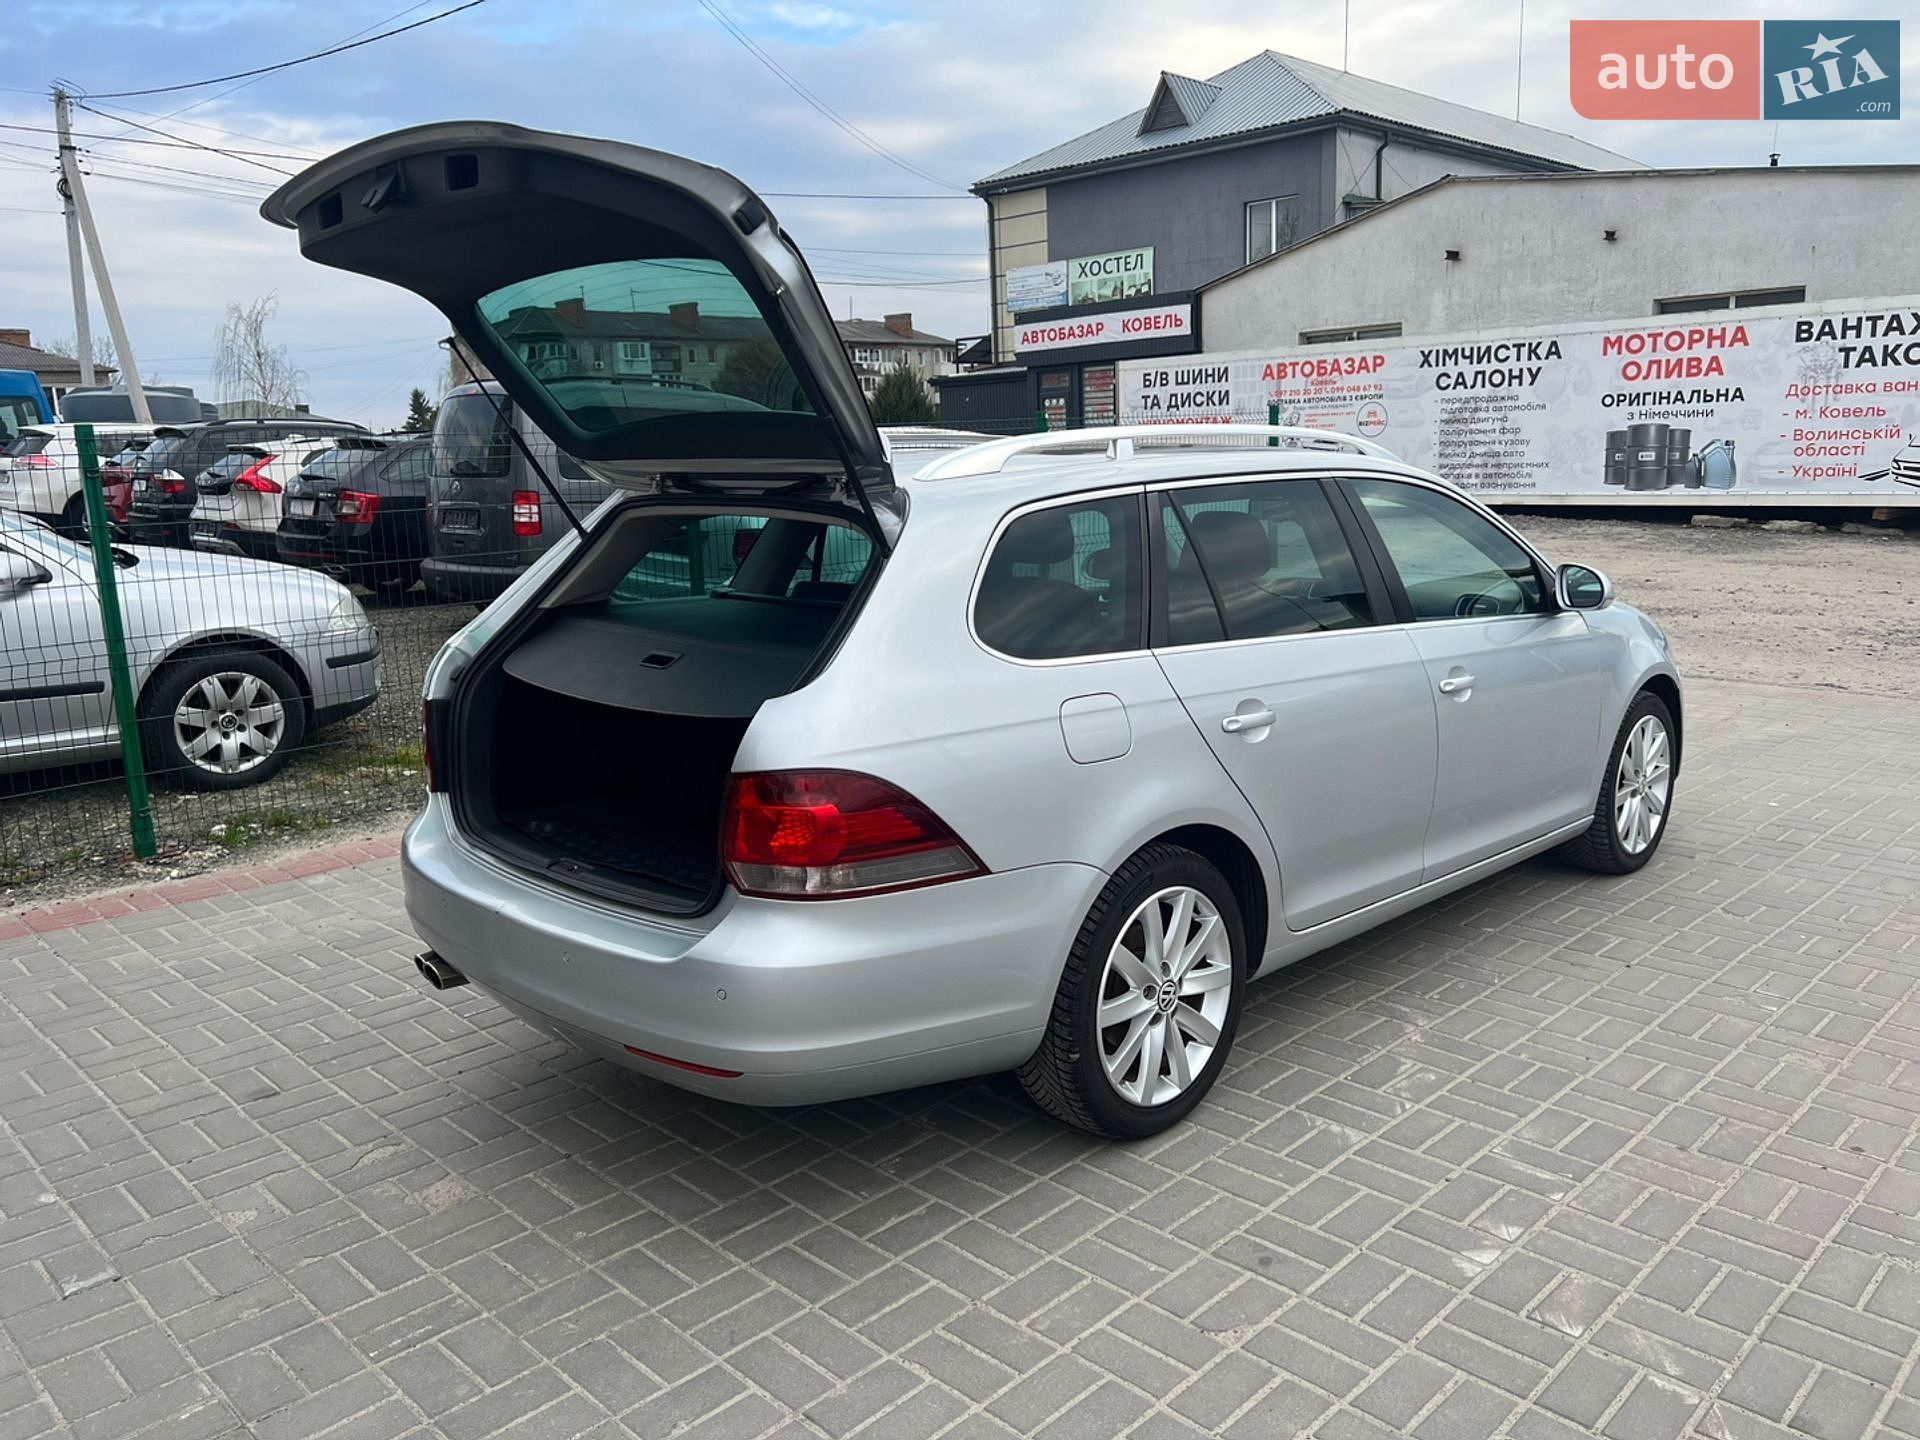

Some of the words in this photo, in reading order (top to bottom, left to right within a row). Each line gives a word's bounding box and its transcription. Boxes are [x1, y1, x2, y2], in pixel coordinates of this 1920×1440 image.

[1078, 253, 1144, 278] ХОСТЕЛ
[1021, 322, 1105, 345] АВТОБАЗАР
[1122, 313, 1184, 334] КОВЕЛЬ
[1602, 326, 1750, 357] МОТОРНА
[1419, 340, 1562, 368] ХІМЧИСТКА
[1838, 342, 1920, 369] ТАКС
[1142, 370, 1169, 388] Б/В
[1175, 366, 1229, 386] ШИНИ
[1262, 355, 1385, 381] АВТОБАЗАР
[1435, 367, 1542, 391] САЛОНУ
[1621, 355, 1724, 382] ОЛИВА
[1141, 394, 1161, 410] ТА
[1167, 389, 1230, 411] ДИСКИ
[1601, 387, 1745, 408] ОРИГІНАЛЬНА
[1785, 382, 1877, 399] Доставка
[1627, 411, 1635, 421] з
[1639, 408, 1714, 420] Німеччини
[1795, 408, 1813, 419] м.
[1819, 406, 1886, 419] Ковель
[1499, 426, 1521, 436] фар
[1793, 424, 1901, 441] Волинській
[1793, 441, 1865, 457] області
[1792, 462, 1858, 480] Україні
